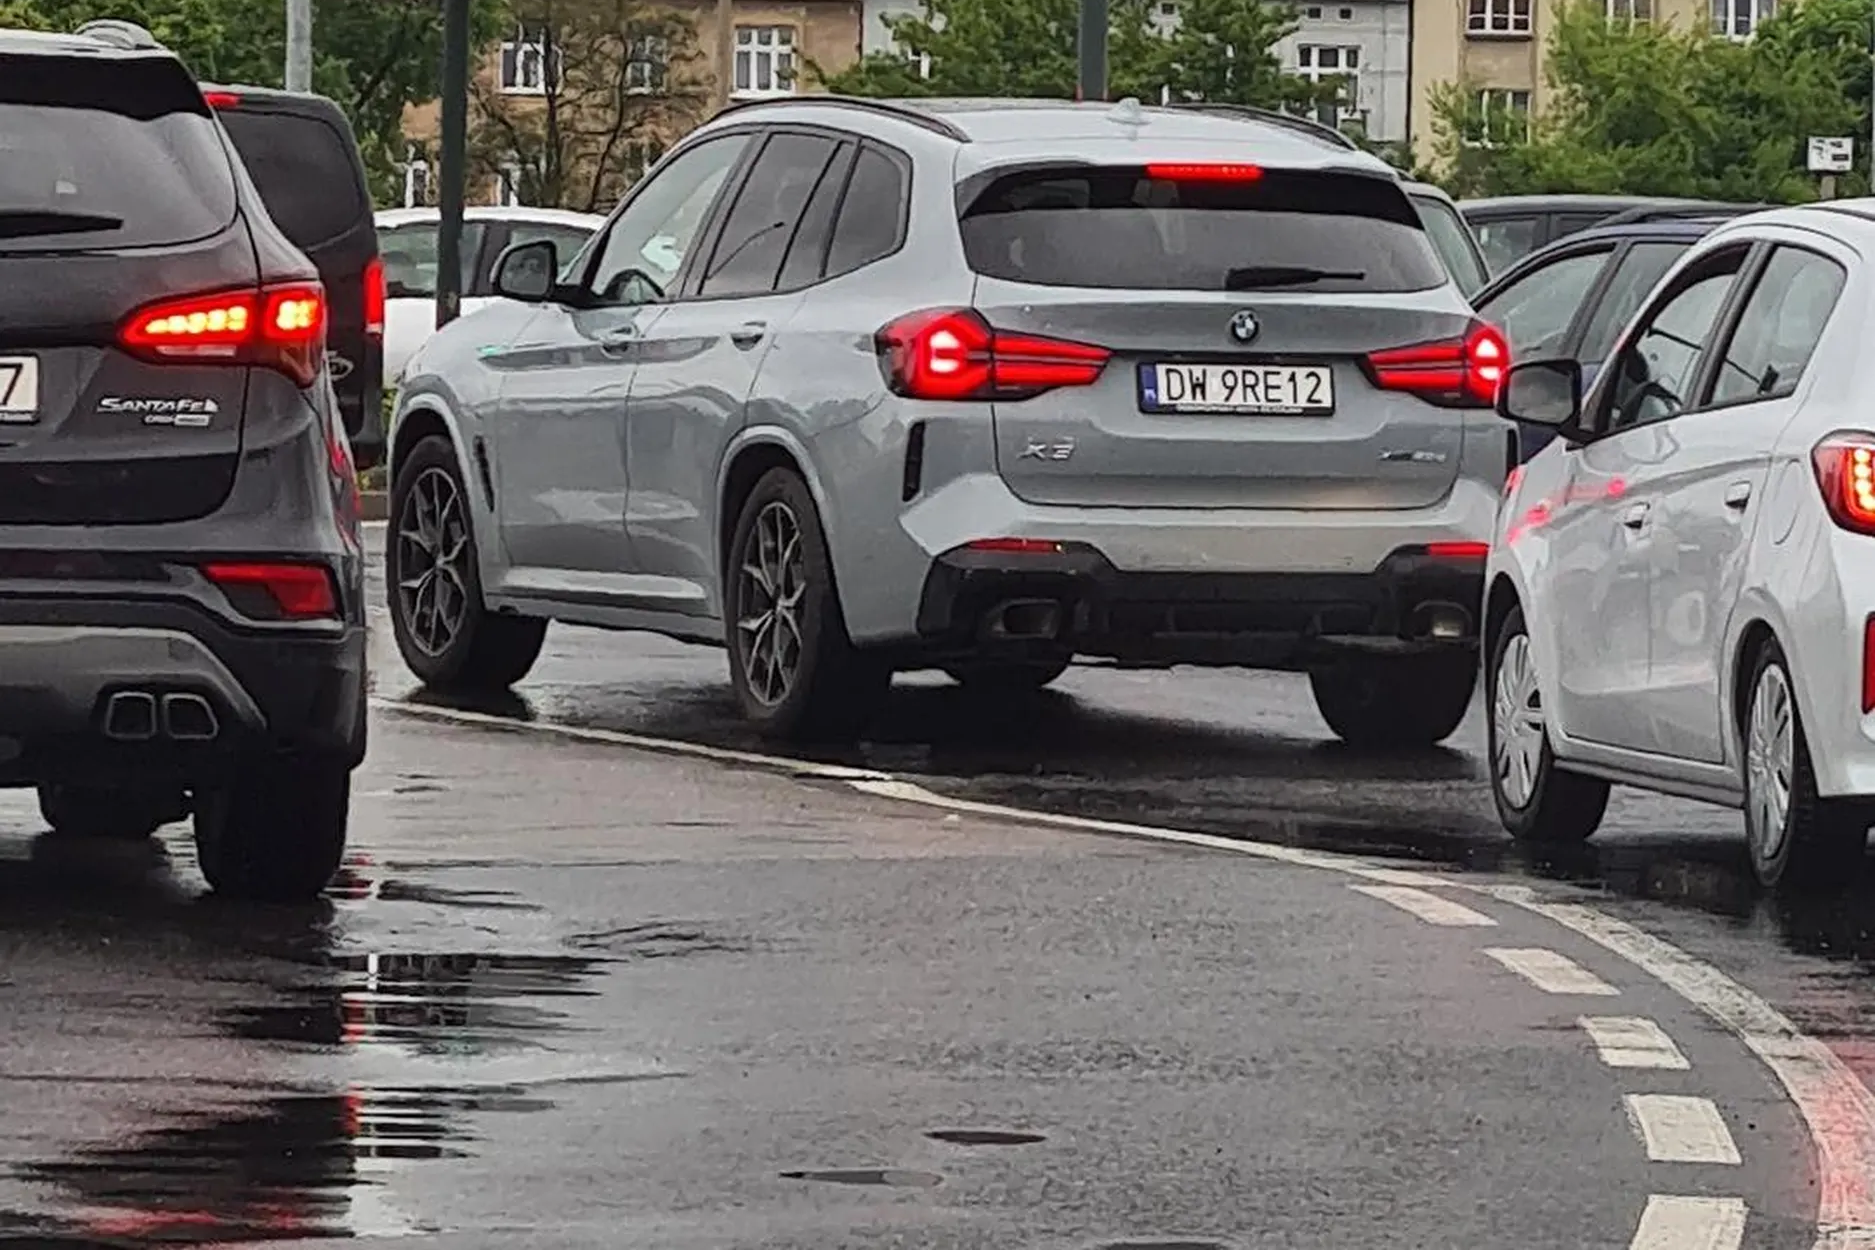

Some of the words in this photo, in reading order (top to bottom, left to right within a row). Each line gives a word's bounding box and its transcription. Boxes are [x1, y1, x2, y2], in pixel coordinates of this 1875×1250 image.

[1165, 367, 1207, 401] DW
[1221, 368, 1322, 404] 9RE12
[1017, 435, 1075, 461] X3
